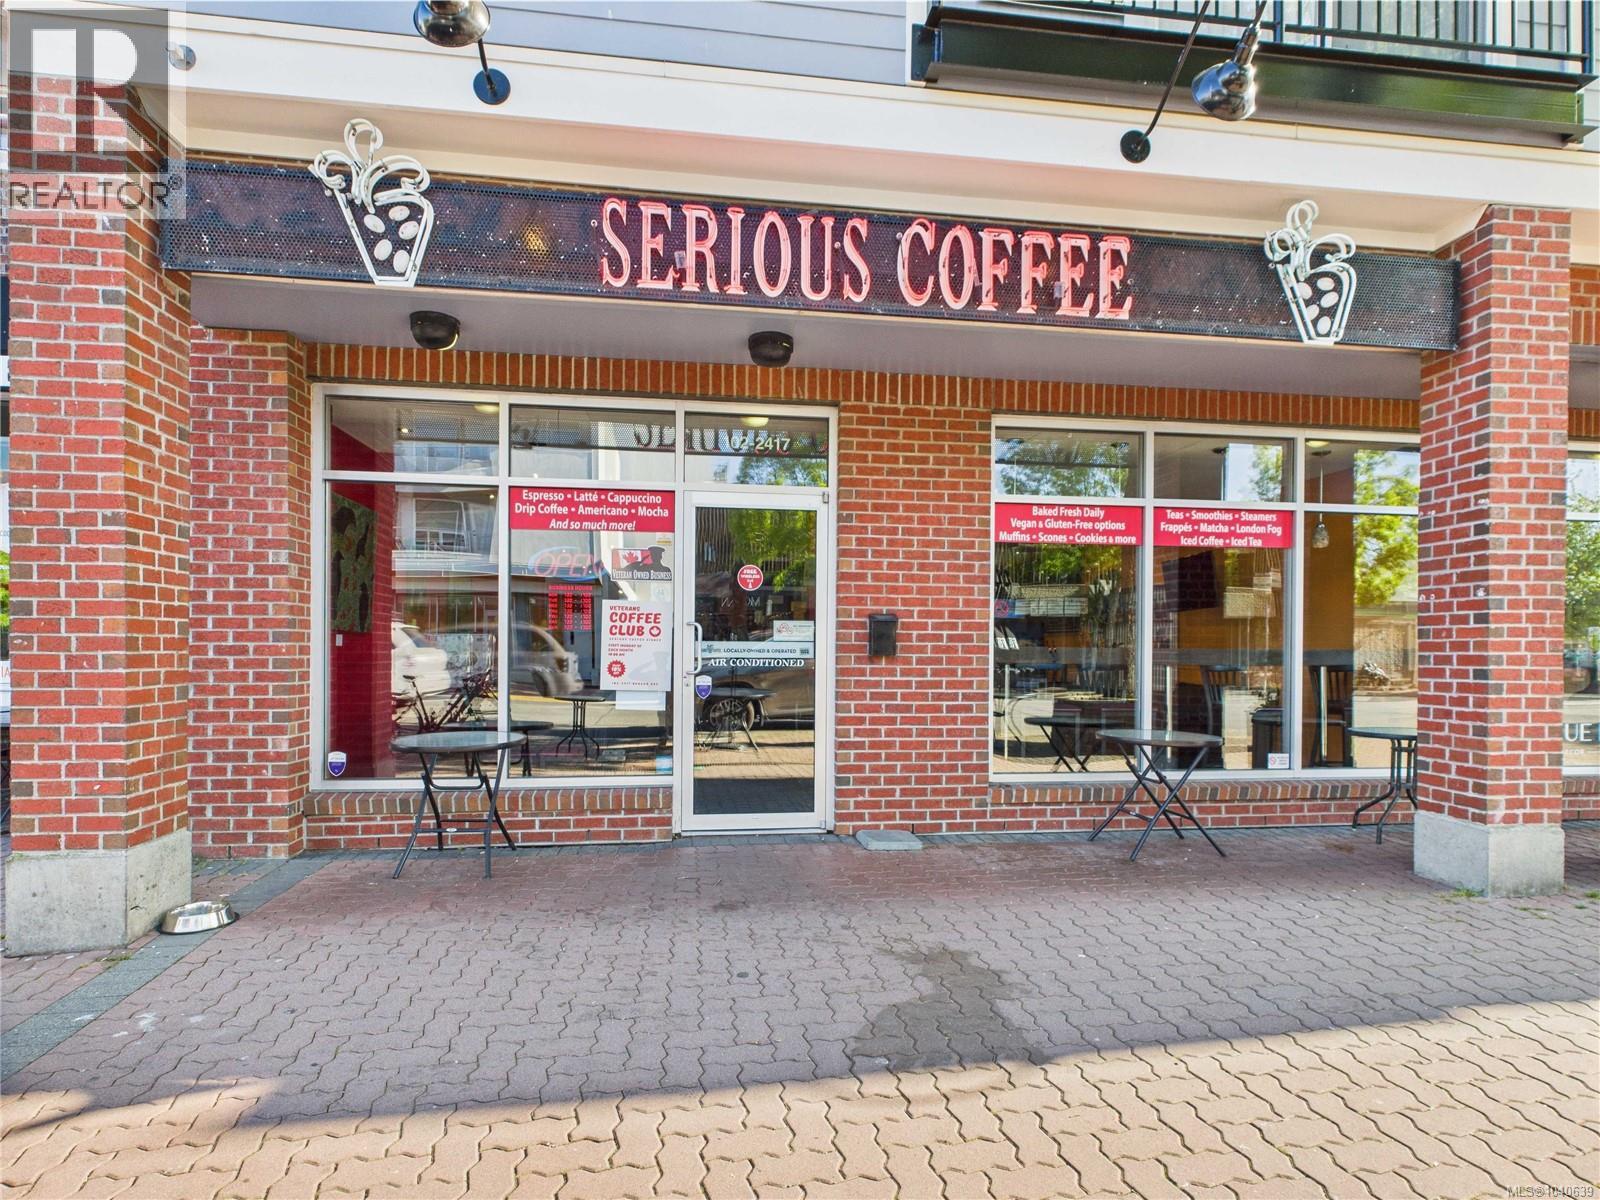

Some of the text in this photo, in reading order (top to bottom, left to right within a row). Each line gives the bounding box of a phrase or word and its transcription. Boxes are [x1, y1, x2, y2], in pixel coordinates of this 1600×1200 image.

[601, 198, 1134, 320] SERIOUS COFFEE
[522, 489, 662, 504] Espresso Latté Cappuccino
[515, 503, 669, 517] Drip Coffee Americano Mocha
[1032, 506, 1105, 519] Baked Fresh Daily
[1166, 509, 1277, 522] Teas Smoothies Steamers
[549, 518, 636, 531] And so much more!
[1010, 518, 1037, 530] Vegan
[1044, 518, 1093, 529] Gluten-Free
[1094, 520, 1126, 532] options
[1160, 522, 1282, 536] Frappés Matcha London Fog
[999, 531, 1030, 541] Muffins
[1038, 532, 1067, 542] Scones
[1075, 532, 1107, 543] Cookies
[1115, 535, 1136, 544] more
[1180, 536, 1263, 547] Iced Coffee Iced Tea
[534, 552, 605, 577] OPEN
[609, 612, 662, 624] COFFEE
[609, 625, 645, 637] CLUB
[708, 658, 805, 667] AIR CONDITIONED
